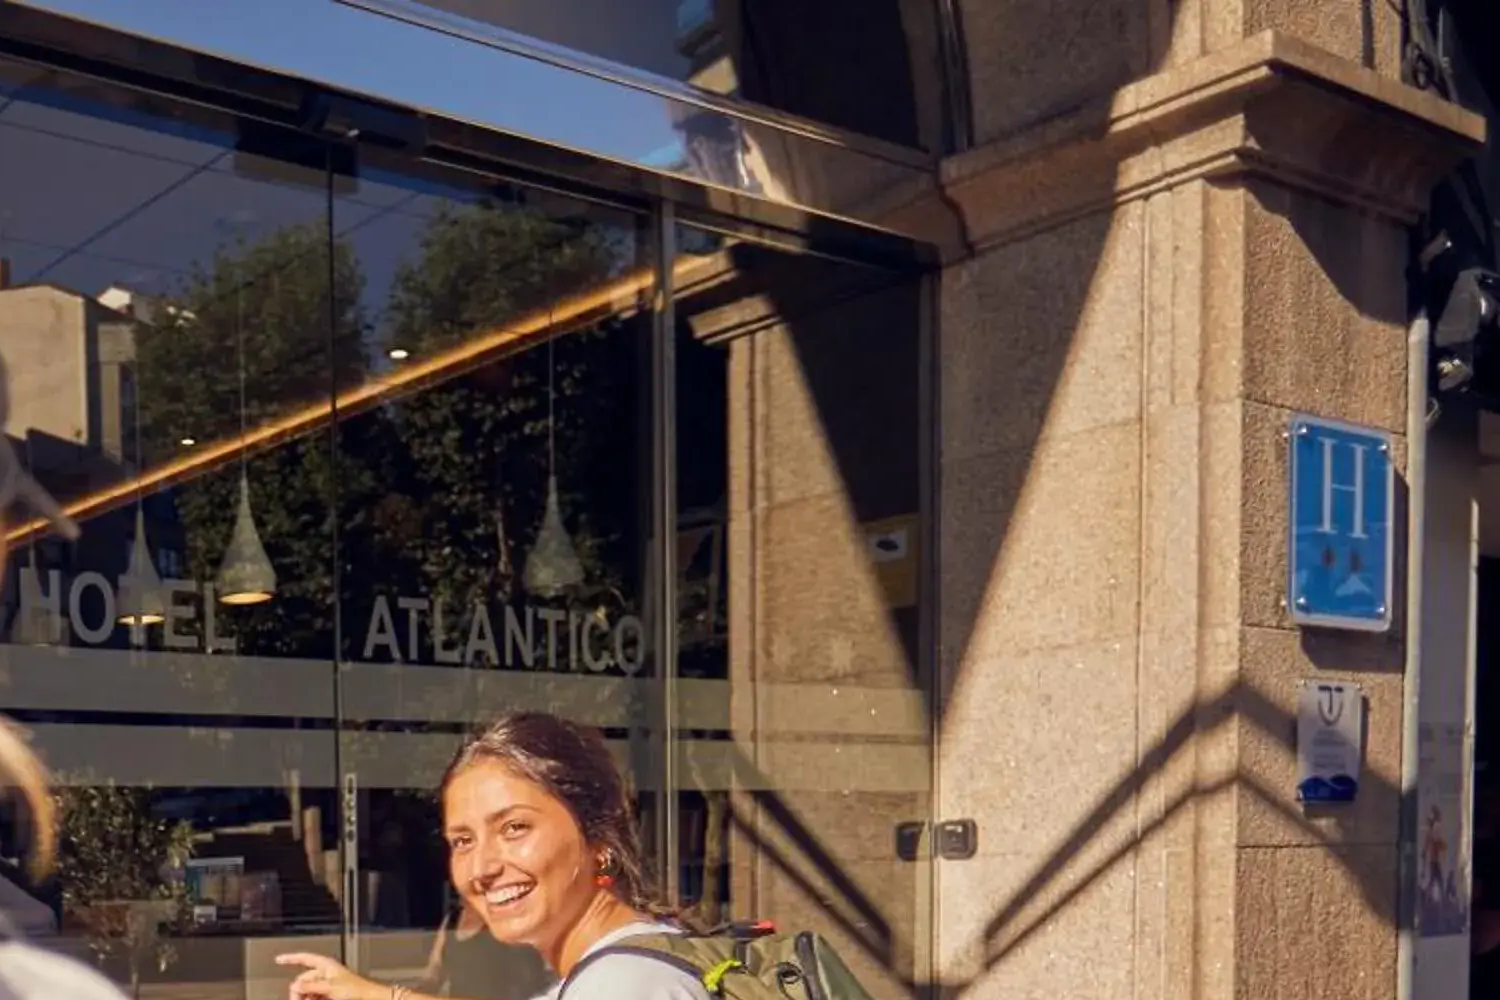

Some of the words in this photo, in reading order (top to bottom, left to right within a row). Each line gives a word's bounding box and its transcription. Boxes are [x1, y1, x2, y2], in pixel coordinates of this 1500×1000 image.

[1316, 436, 1369, 539] H
[19, 567, 238, 649] HOTEL
[363, 595, 645, 674] ATLANTICO
